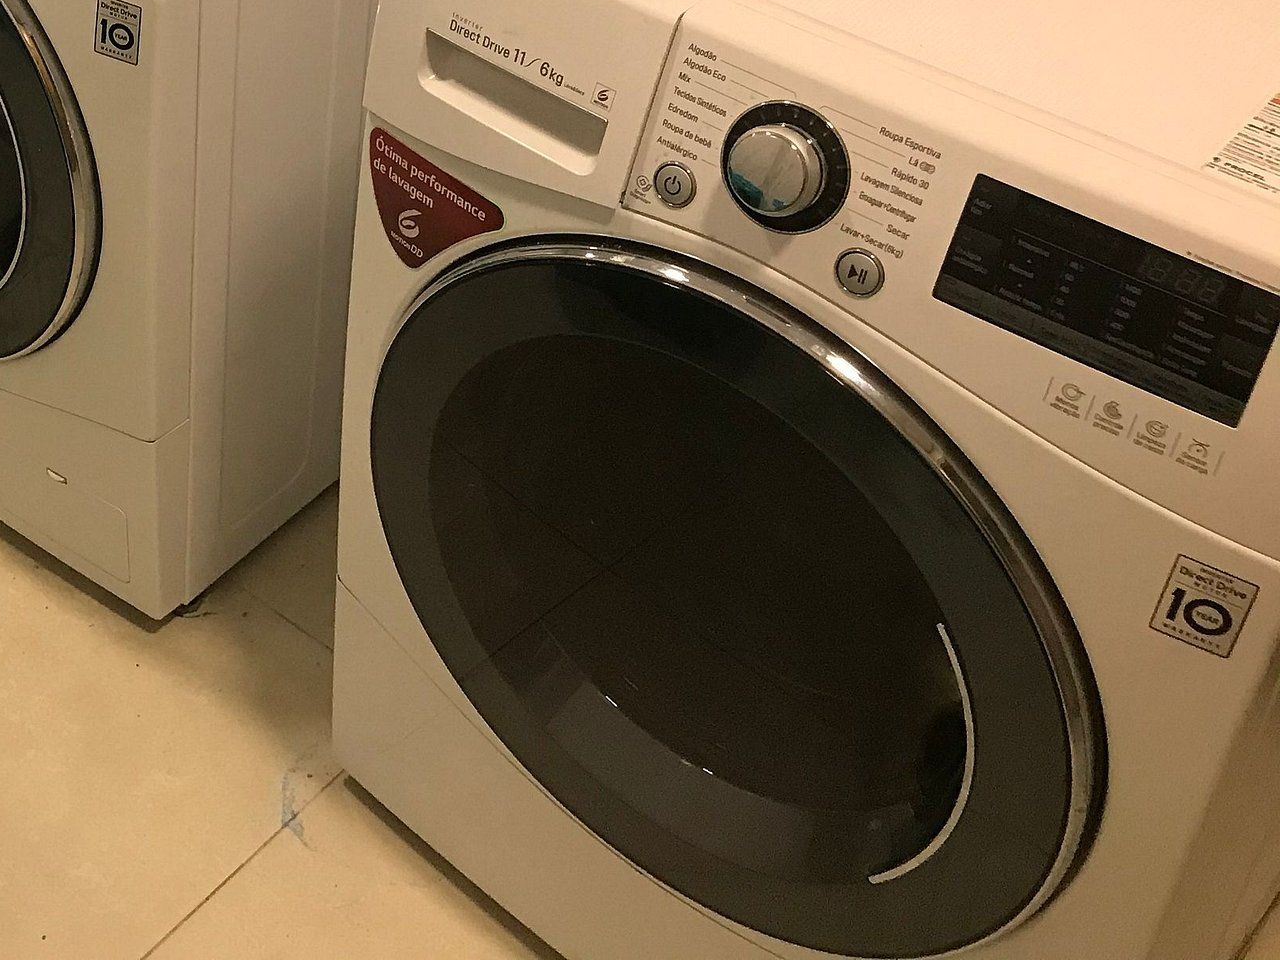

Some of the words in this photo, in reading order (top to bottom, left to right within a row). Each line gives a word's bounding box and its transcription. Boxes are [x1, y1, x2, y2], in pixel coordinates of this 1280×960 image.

[101, 1, 119, 13] Direct
[120, 8, 137, 19] Drive
[100, 18, 135, 51] 10
[449, 19, 481, 45] Direct
[481, 35, 510, 58] Drive
[688, 43, 717, 62] Algodão
[678, 71, 691, 83] Mix
[683, 57, 712, 76] Algodão
[712, 70, 726, 82] Eco
[674, 86, 696, 103] Tecidos
[668, 103, 698, 123] Edredom
[662, 118, 683, 136] Roupa
[684, 130, 694, 139] de
[694, 134, 711, 149] bebê
[879, 127, 903, 143] Roupa
[904, 137, 941, 159] Esportiva
[657, 136, 698, 161] Antialérgico
[373, 158, 386, 174] de
[389, 167, 433, 208] lavagem
[376, 135, 408, 171] Ótima
[410, 165, 486, 221] performance
[861, 172, 889, 191] Lavagem
[891, 167, 917, 185] Rápido
[918, 180, 929, 190] 30
[886, 224, 910, 240] Secar
[1179, 566, 1214, 585] Direct
[1216, 581, 1247, 599] Drive
[1165, 587, 1233, 636] 10
[1195, 610, 1220, 625] YEAR
